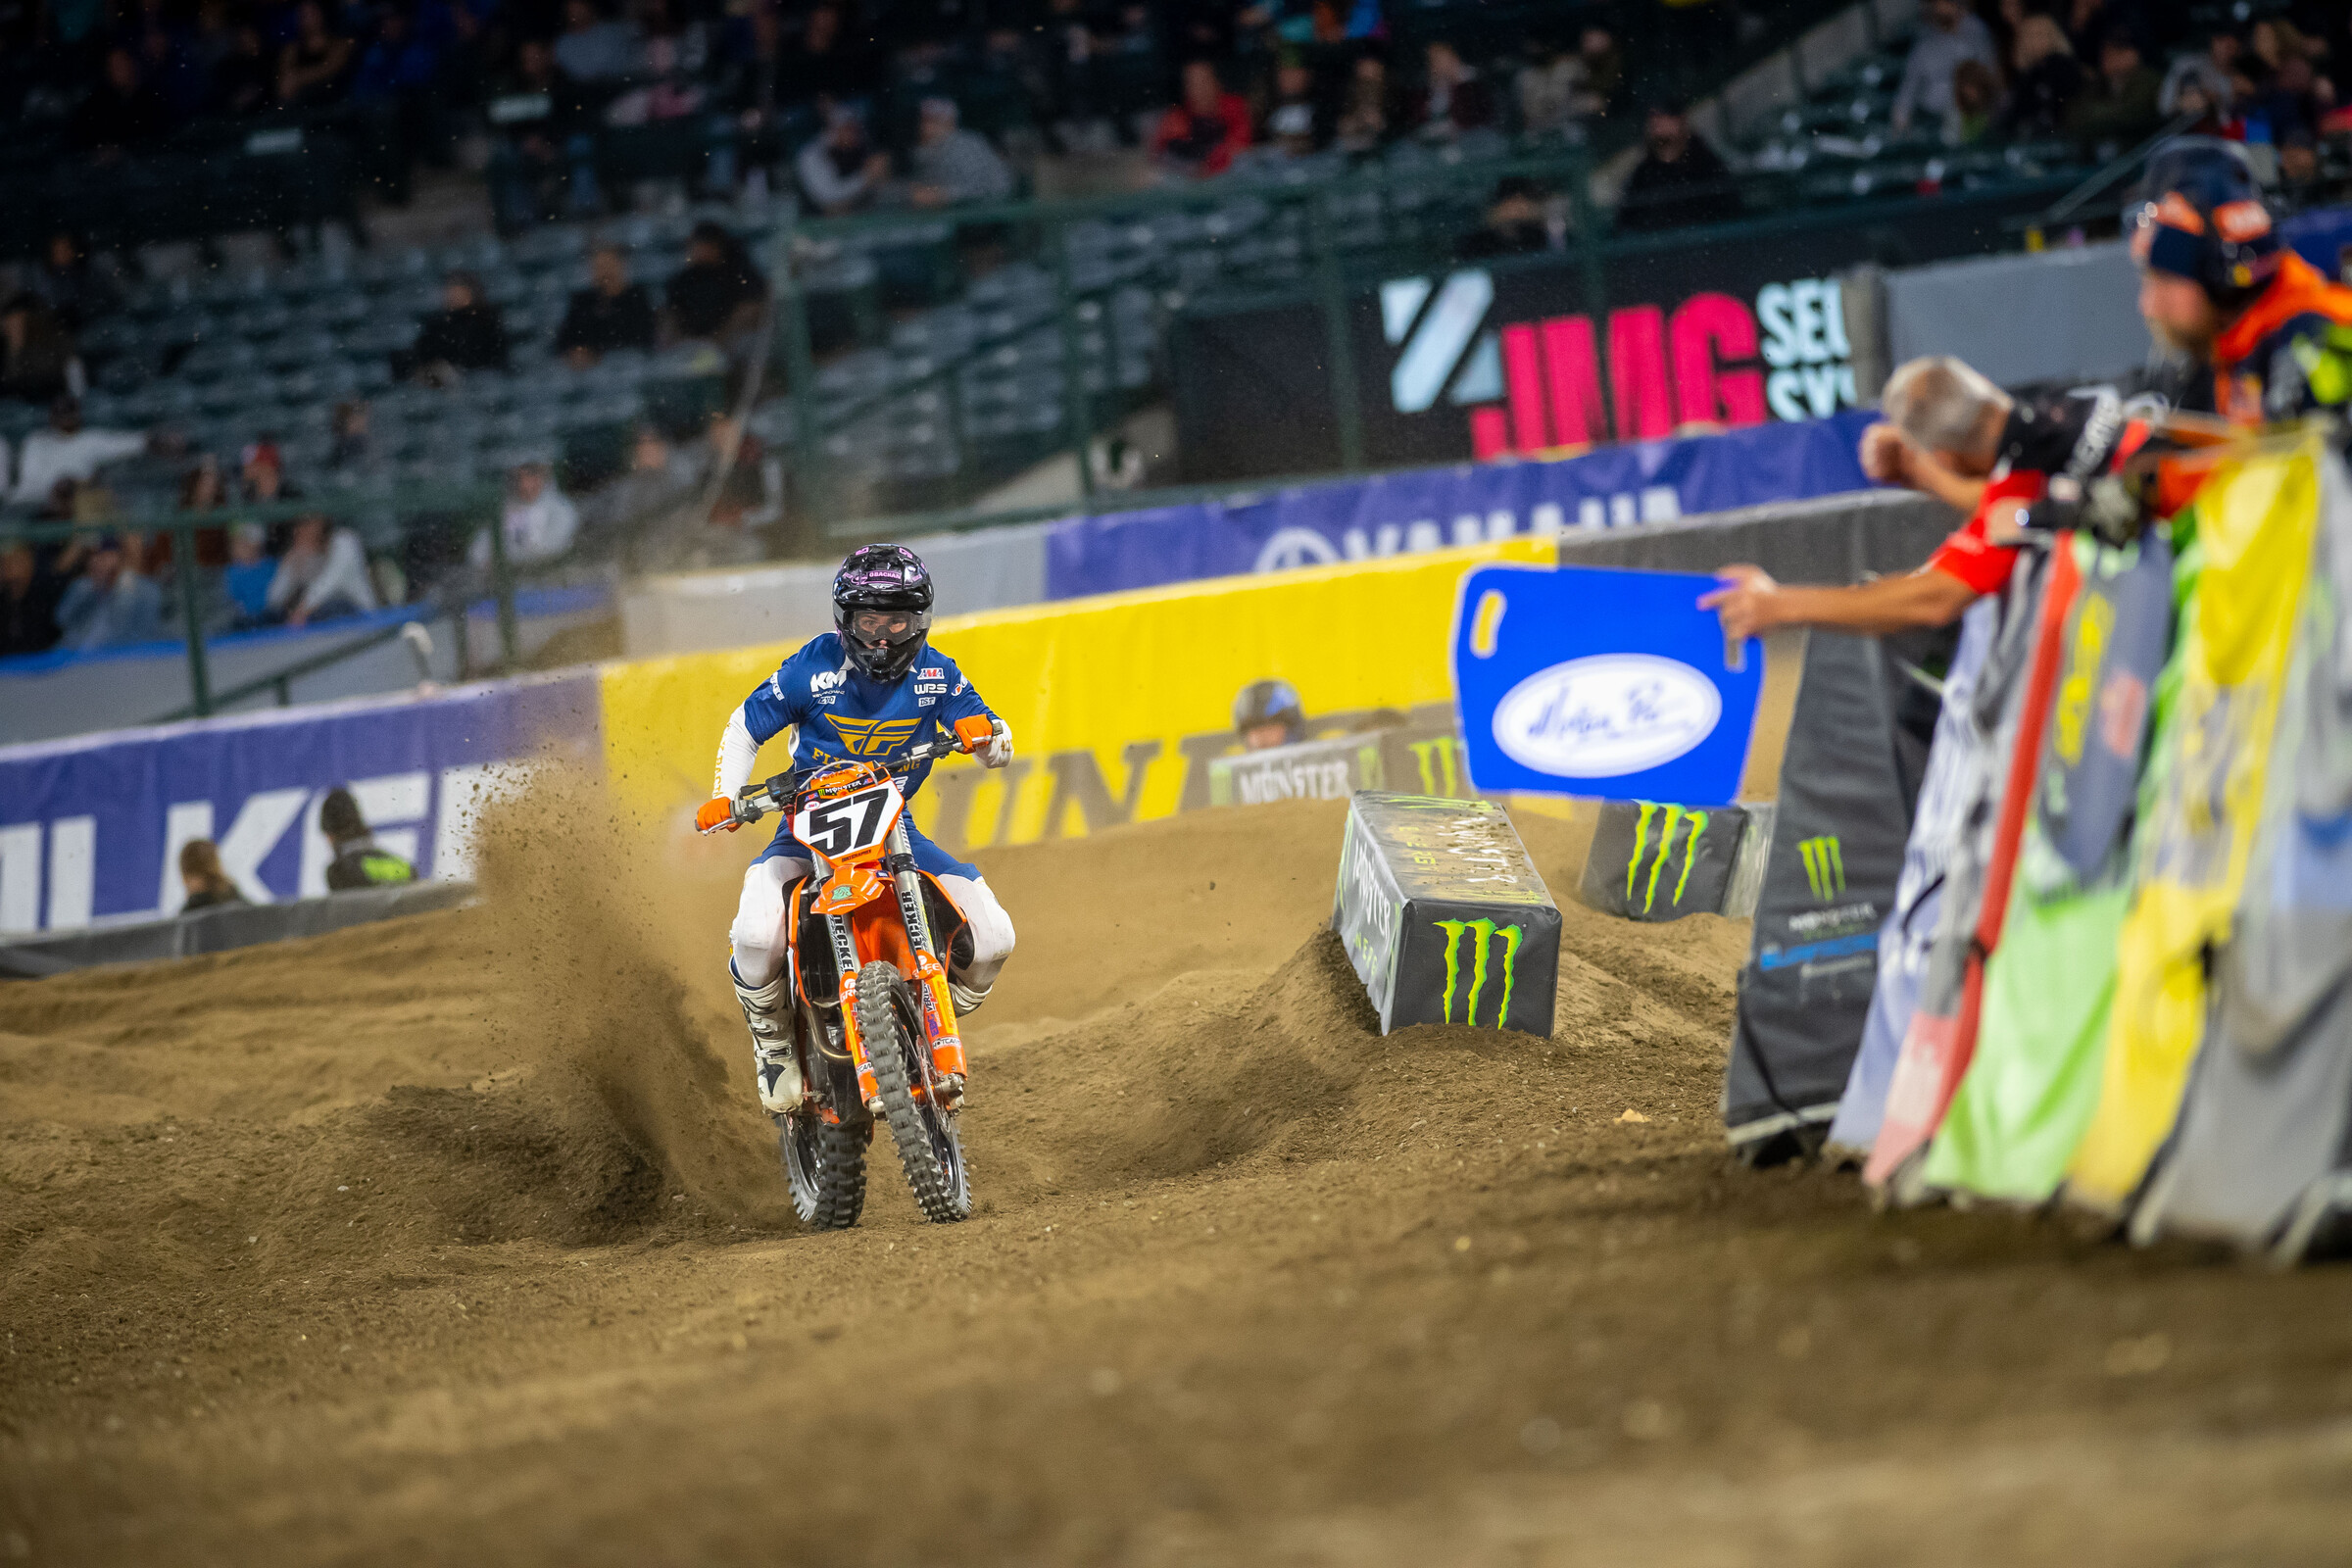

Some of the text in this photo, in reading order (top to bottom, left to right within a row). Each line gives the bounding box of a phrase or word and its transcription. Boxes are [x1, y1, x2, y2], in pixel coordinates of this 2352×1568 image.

[913, 683, 948, 695] WPS
[825, 780, 862, 794] MONSTER
[809, 788, 889, 858] 57
